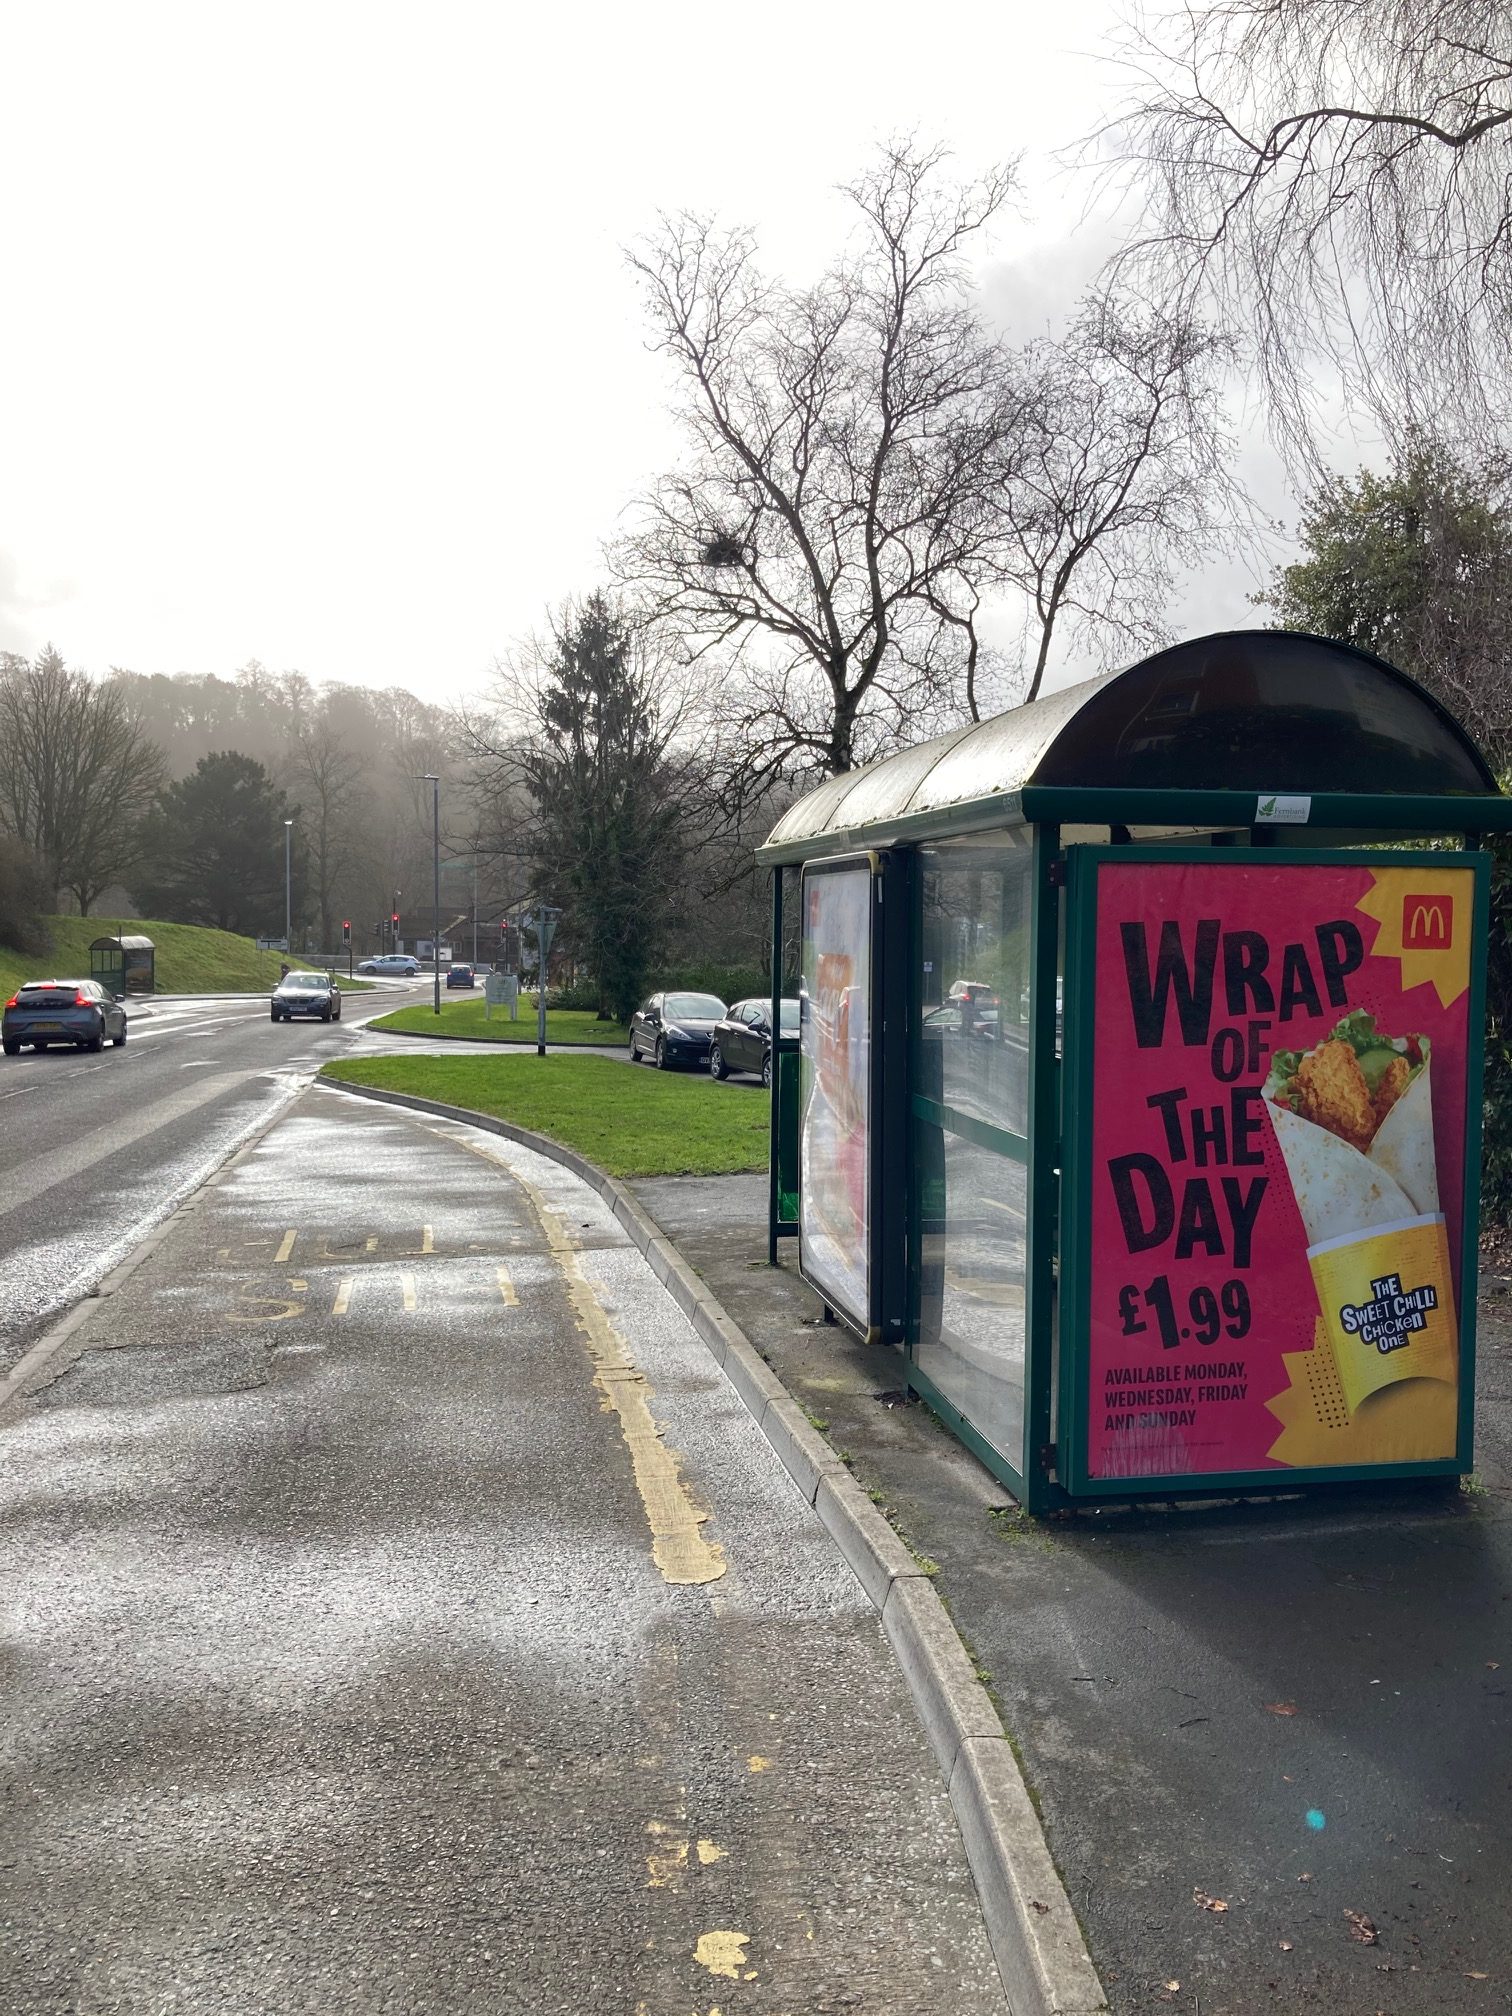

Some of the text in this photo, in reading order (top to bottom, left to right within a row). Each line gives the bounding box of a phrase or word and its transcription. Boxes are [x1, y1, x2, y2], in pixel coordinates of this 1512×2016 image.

[1120, 918, 1364, 1049] WRAP
[1211, 1020, 1271, 1083] OF
[1146, 1086, 1266, 1168] THE
[1107, 1152, 1268, 1269] DAY
[1372, 1277, 1399, 1299] THE
[1118, 1274, 1252, 1350] £1.99
[1342, 1300, 1390, 1331] SWEET
[1105, 1361, 1248, 1386] AVAILABLE MONDAY,
[1105, 1384, 1249, 1409] WEDNESDAY, FRIDAY
[1105, 1409, 1197, 1431] AND SUNDAY
